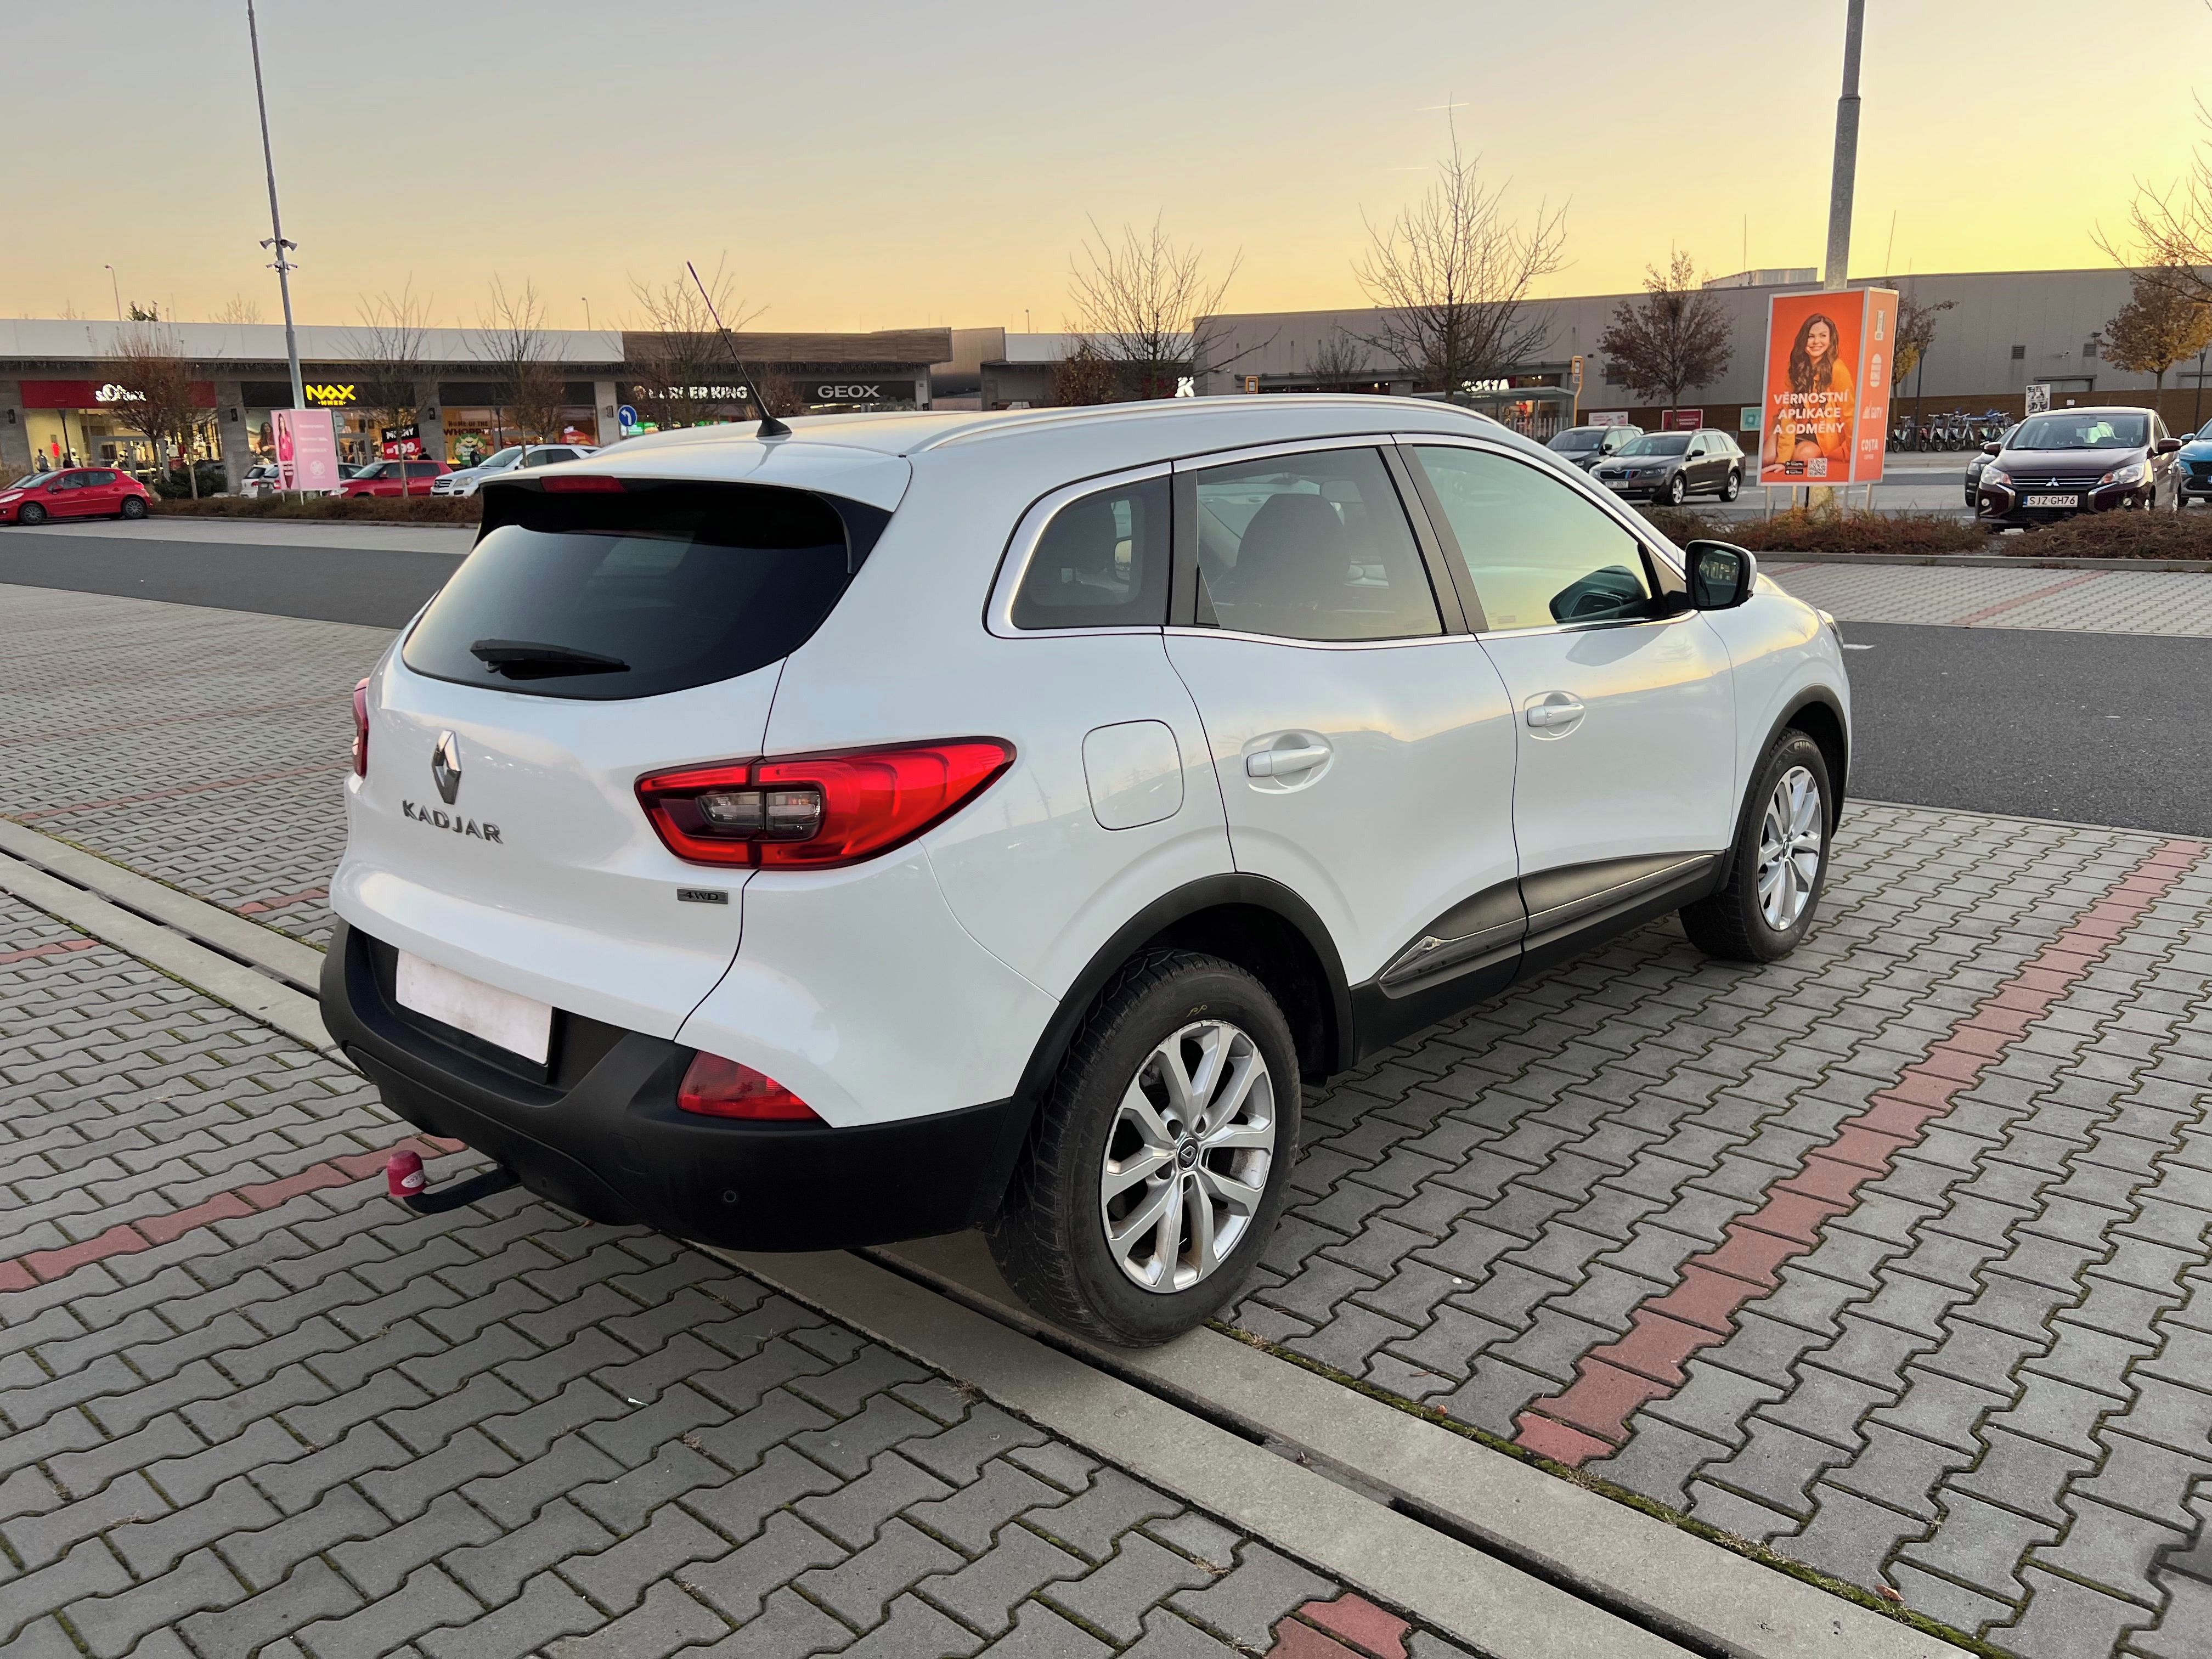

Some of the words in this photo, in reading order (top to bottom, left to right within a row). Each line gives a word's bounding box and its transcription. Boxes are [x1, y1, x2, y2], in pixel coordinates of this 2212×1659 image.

[710, 386, 748, 399] KING
[817, 385, 881, 398] GEOX
[1773, 389, 1849, 404] VĚRNOSTNÍ
[1778, 407, 1841, 420] APLIKACE
[1773, 424, 1782, 435] A
[1785, 421, 1845, 435] ODMĚNY
[2029, 496, 2048, 505] SJZ
[2051, 496, 2075, 505] GH76
[403, 799, 504, 844] KADJAR
[685, 891, 719, 900] 4WD
